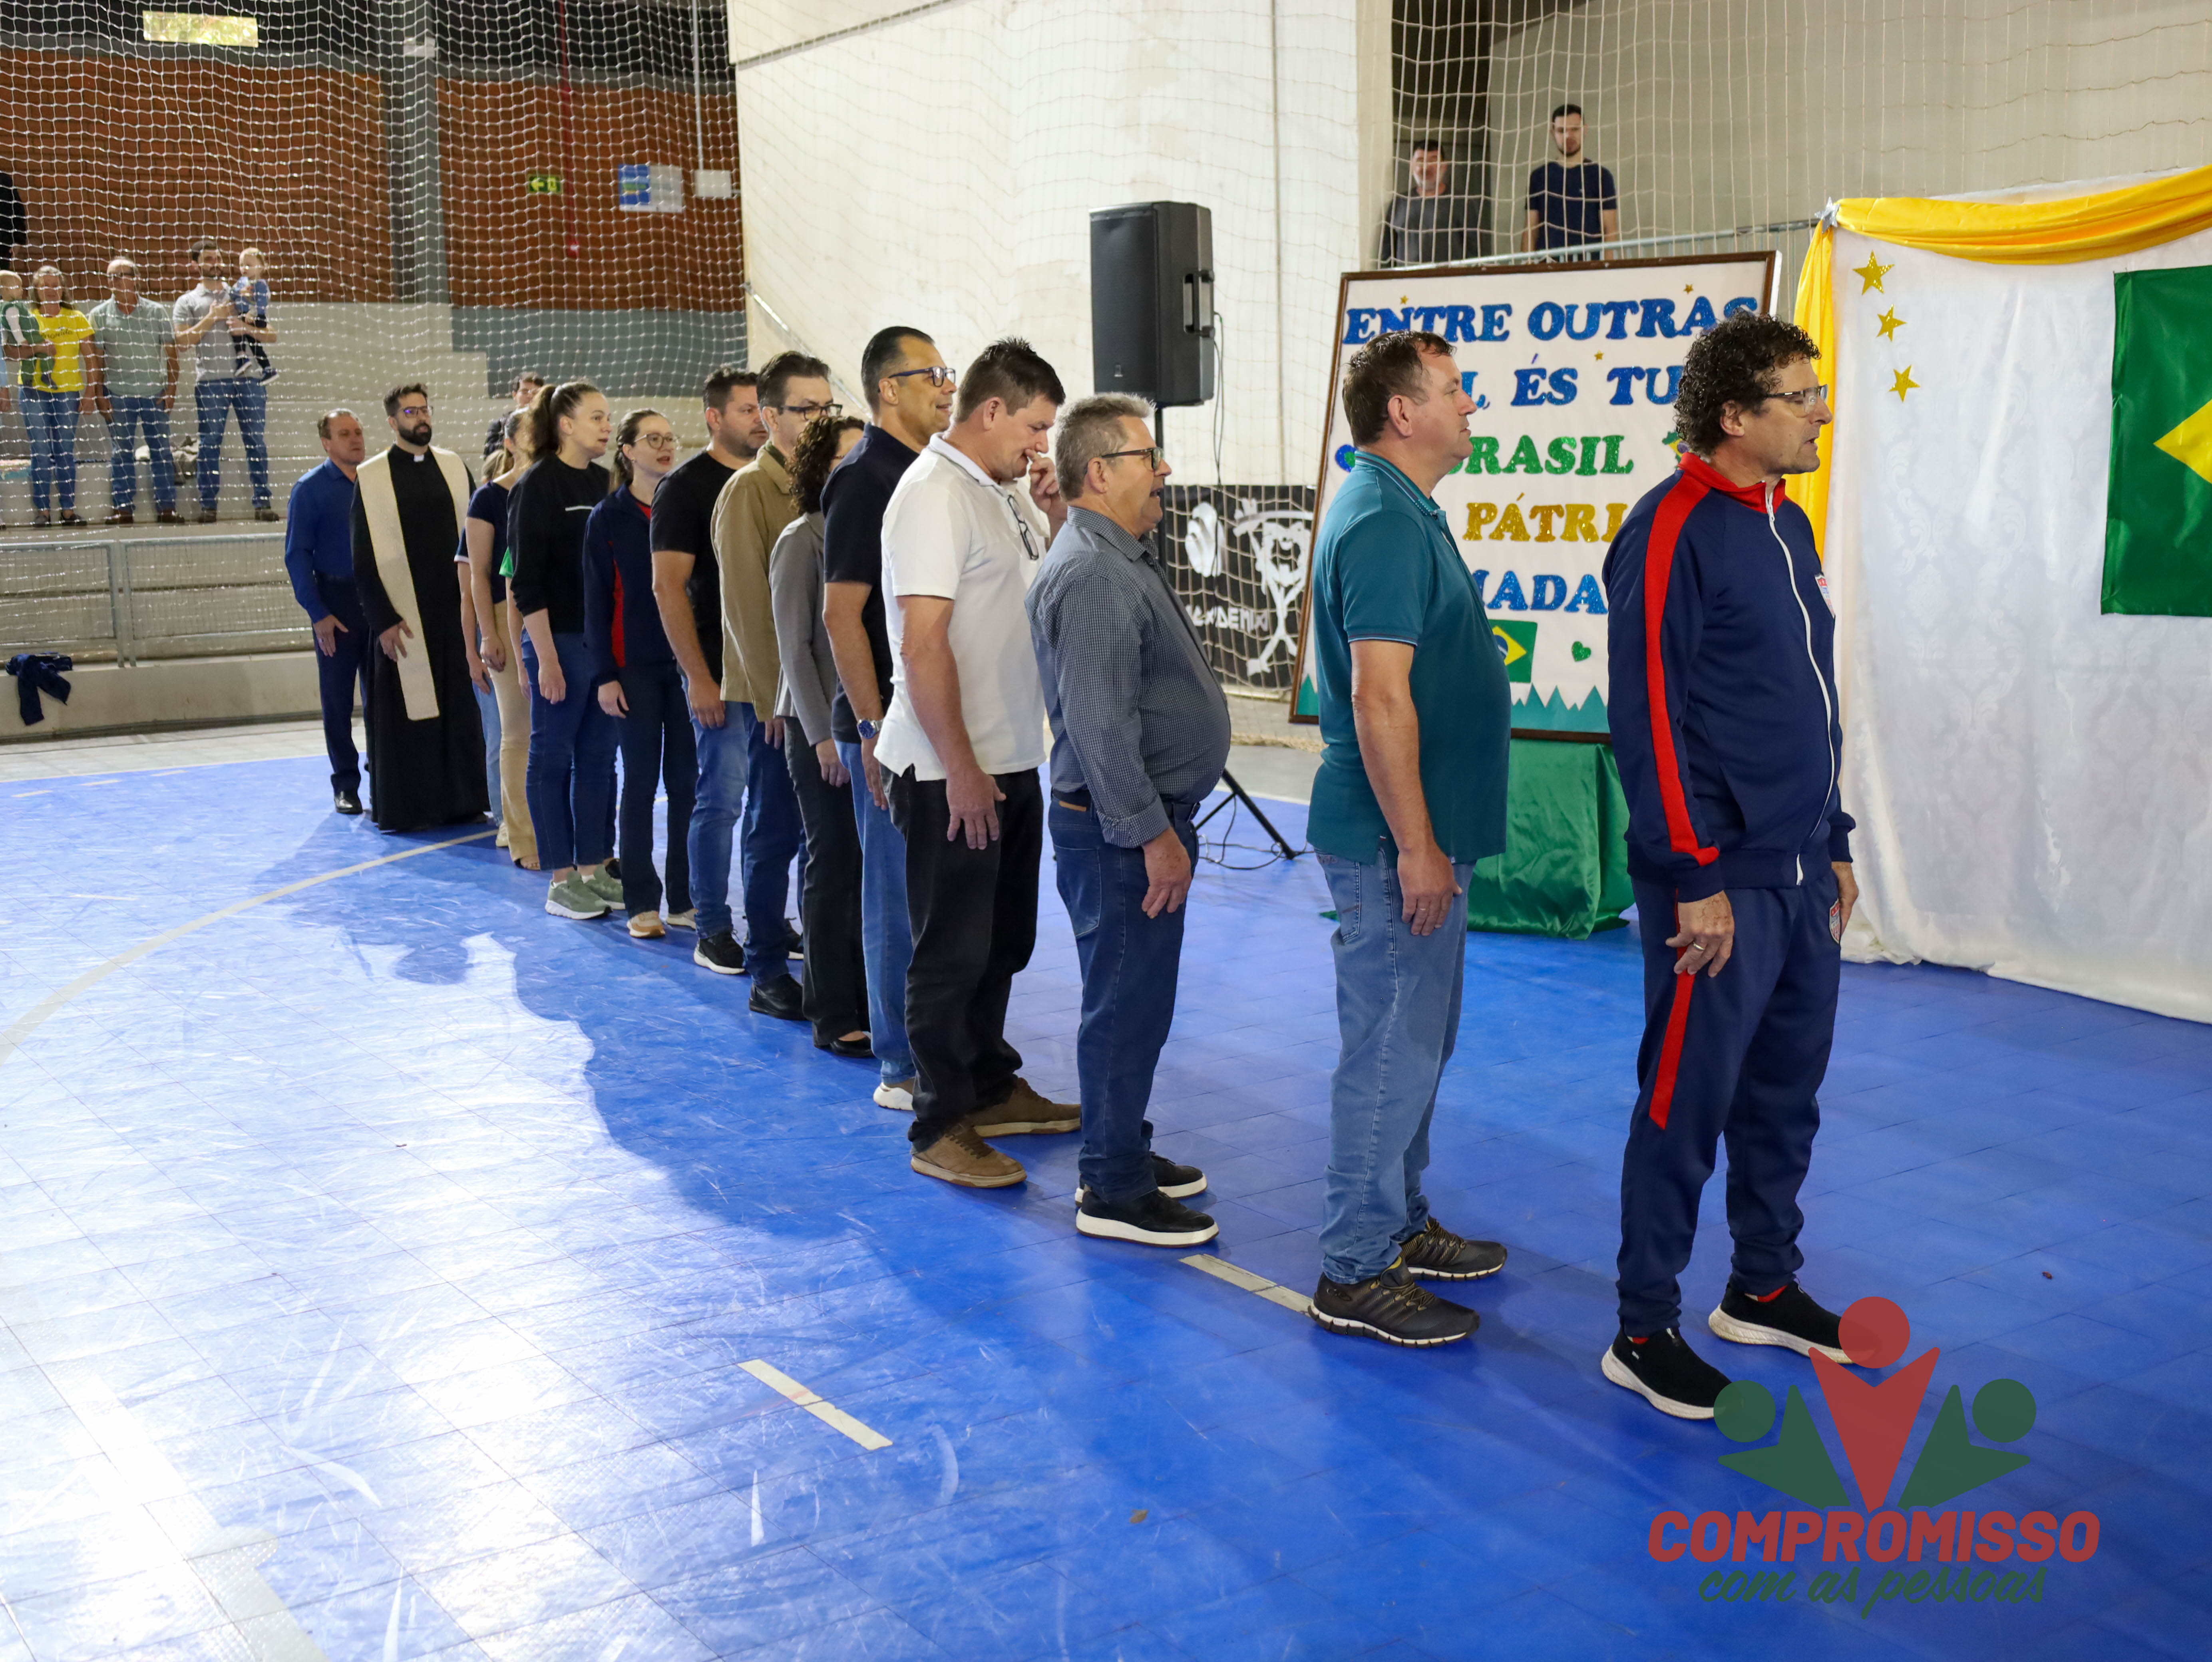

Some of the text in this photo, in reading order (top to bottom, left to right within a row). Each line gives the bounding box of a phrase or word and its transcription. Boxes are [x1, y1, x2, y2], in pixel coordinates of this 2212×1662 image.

[1342, 304, 1512, 344] ENTRE
[1511, 353, 1577, 406] ÉS
[1607, 365, 1681, 405] TU
[1447, 434, 1634, 476] RASIL
[1462, 492, 1628, 543] PÁTRI
[1470, 570, 1609, 614] ADA
